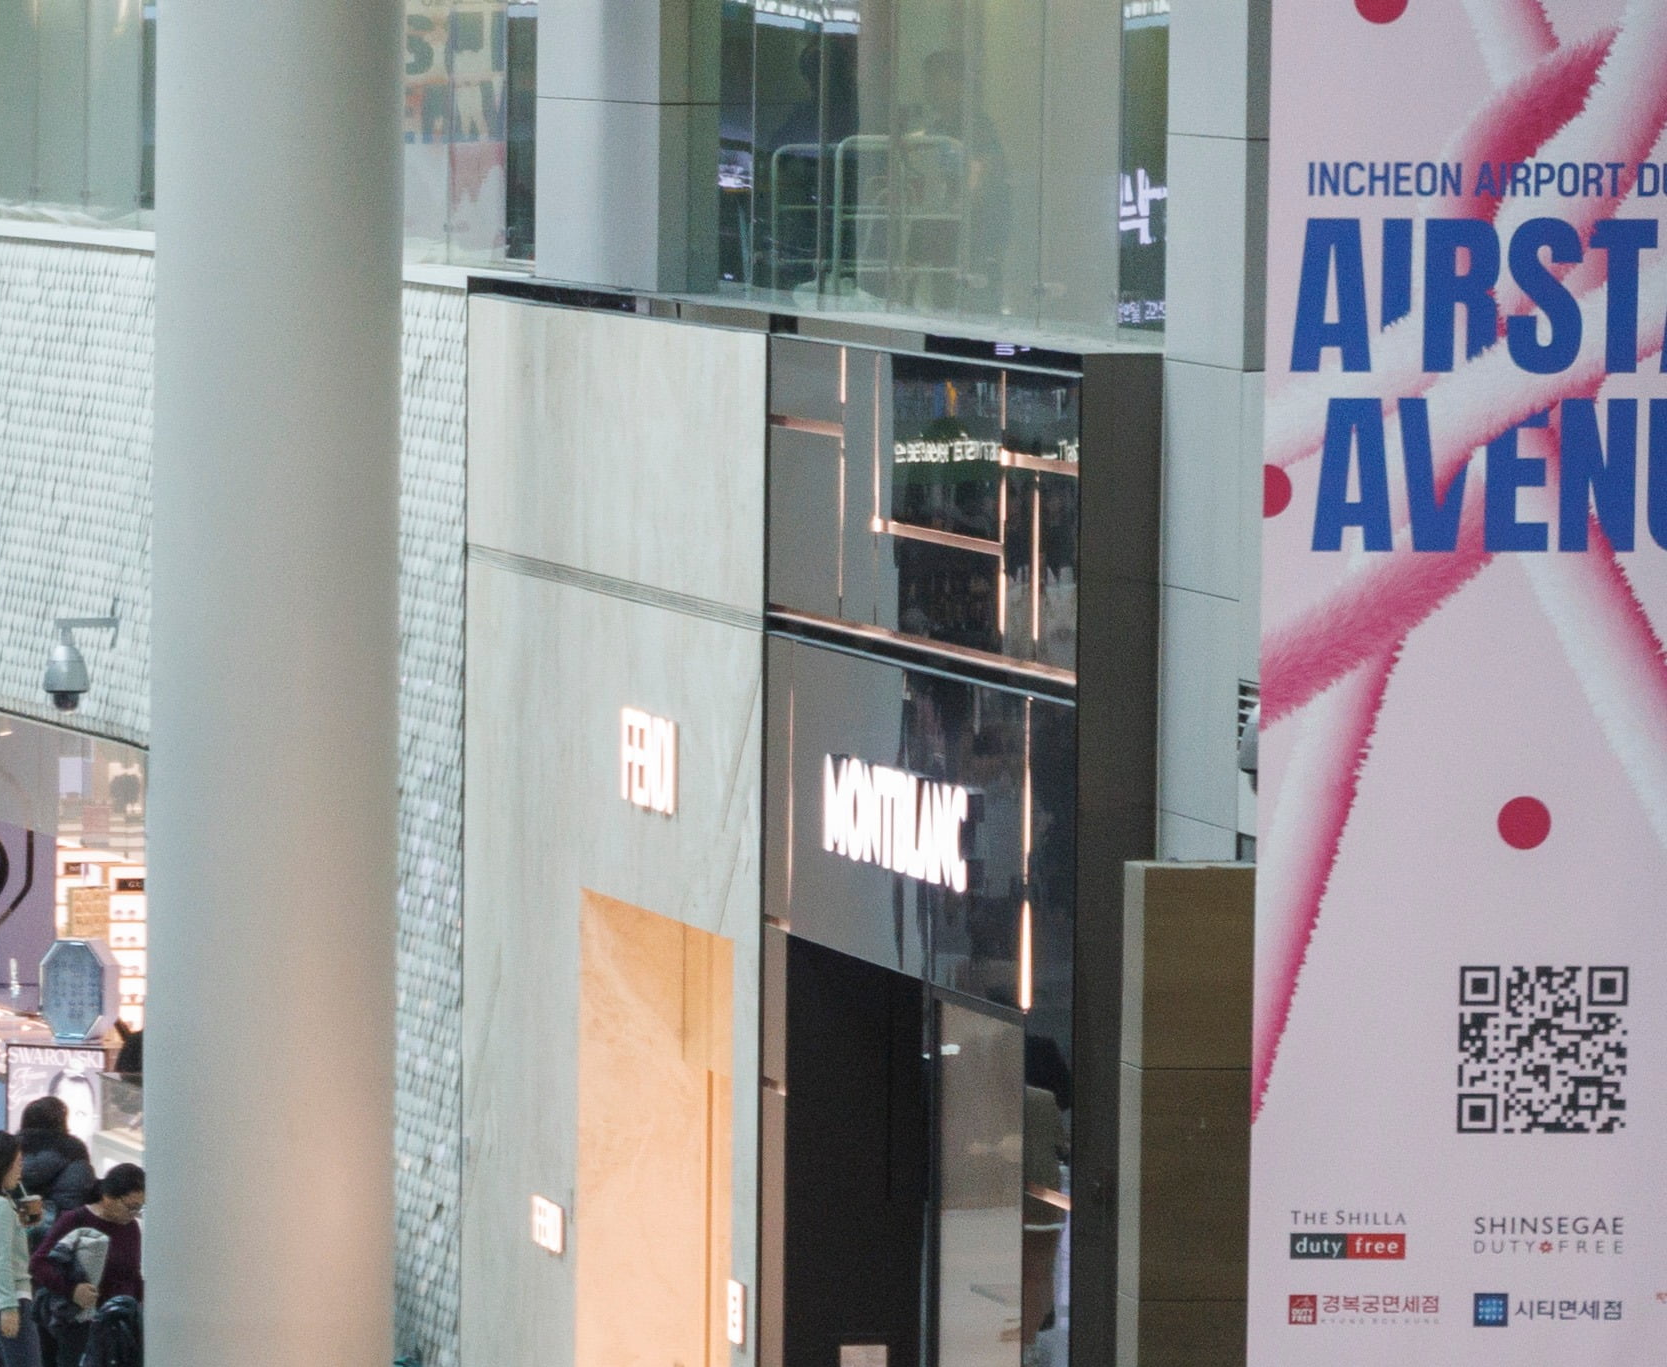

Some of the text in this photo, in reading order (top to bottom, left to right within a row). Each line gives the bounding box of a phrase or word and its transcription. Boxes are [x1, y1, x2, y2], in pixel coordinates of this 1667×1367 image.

[1307, 161, 1463, 197] INCHEON
[1474, 162, 1626, 197] AIRPORT
[1289, 216, 1667, 375] AIRST
[1311, 397, 1667, 553] AVEN
[619, 704, 676, 815] FENDI
[822, 752, 969, 894] MONTBLANC
[8, 1046, 105, 1069] SWAROVSKI
[1290, 1209, 1407, 1226] THE SHILLA
[1473, 1216, 1625, 1235] SHINSEGAE
[1294, 1236, 1400, 1258] duty free
[1473, 1240, 1624, 1255] DUTY FREE
[1321, 1294, 1441, 1315] 경복궁면세점
[1513, 1299, 1624, 1321] 시티면세점
